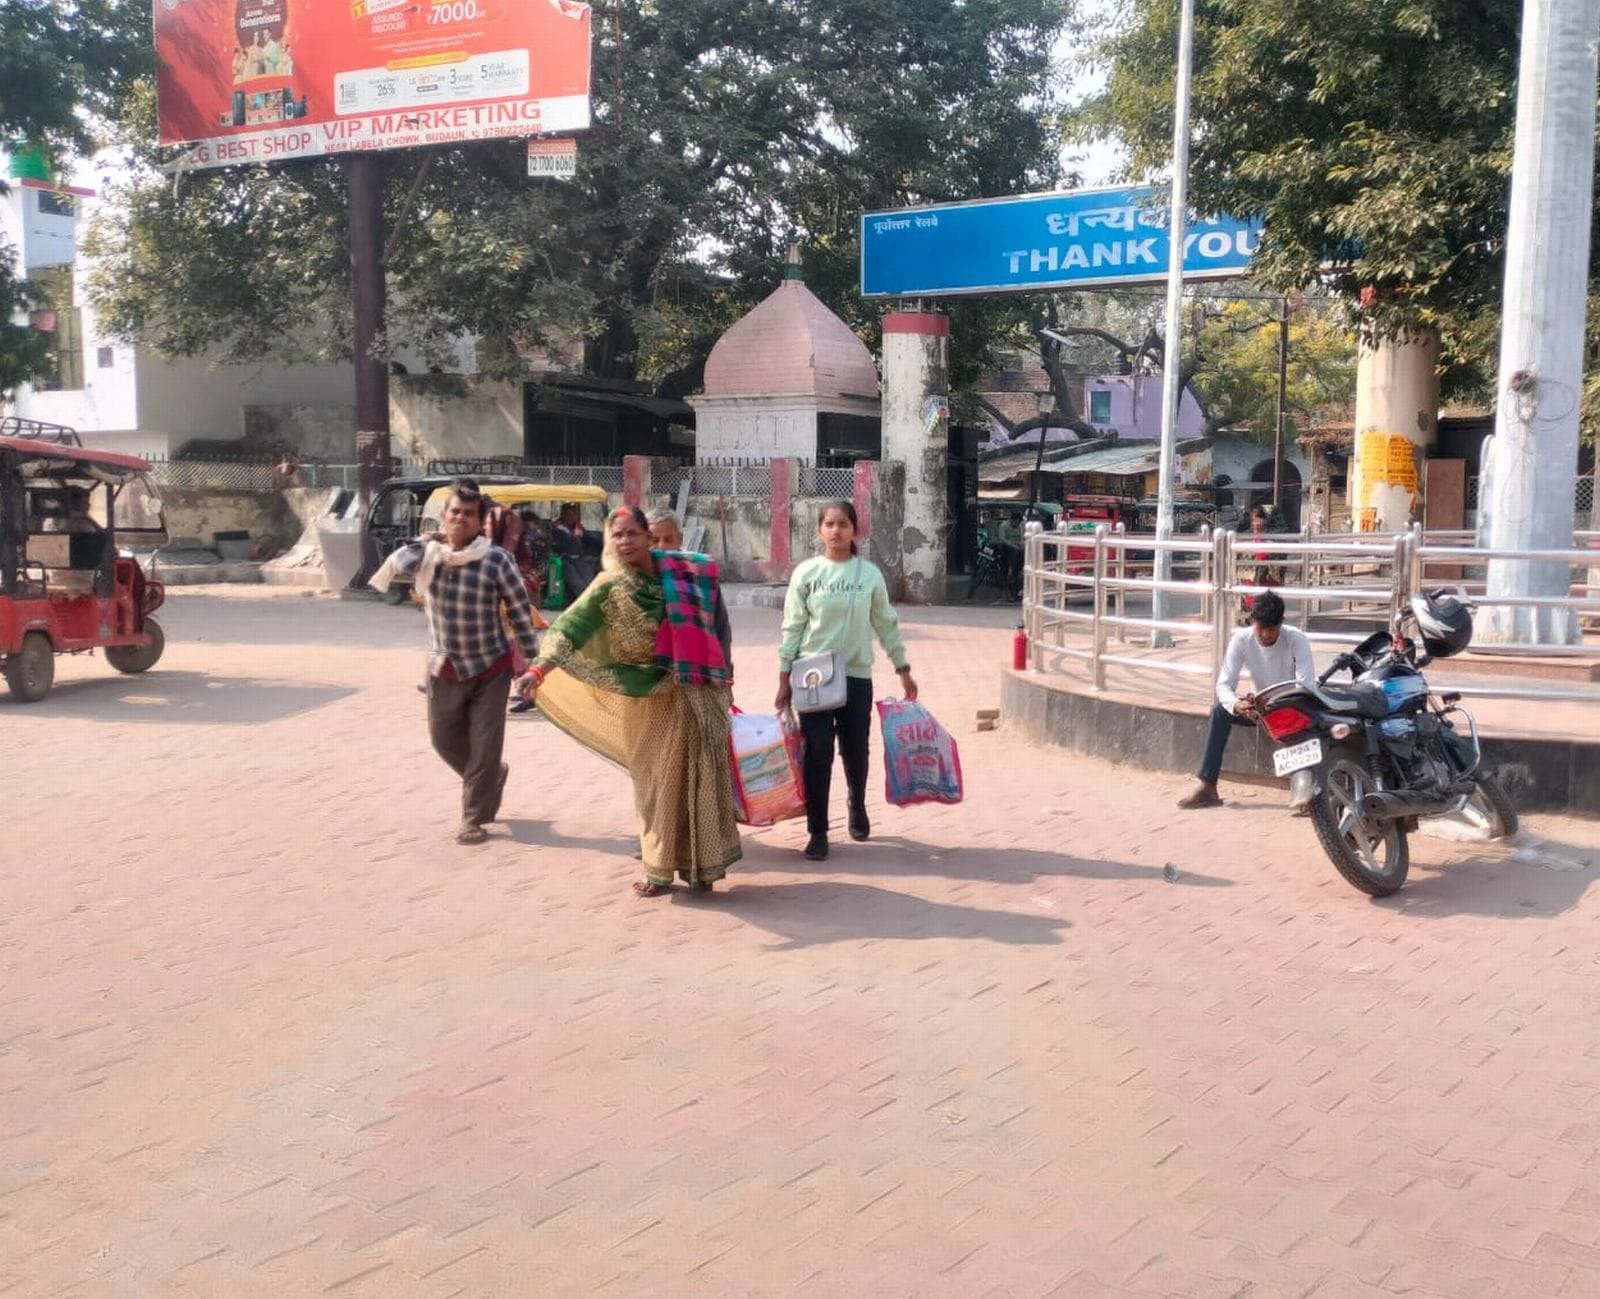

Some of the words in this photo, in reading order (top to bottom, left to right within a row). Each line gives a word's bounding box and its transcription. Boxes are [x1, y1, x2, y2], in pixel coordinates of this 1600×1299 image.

[322, 120, 363, 140] VIP
[371, 101, 541, 135] MARKETING
[216, 139, 258, 160] BEST
[263, 132, 312, 154] SHOP
[324, 142, 348, 151] NEAR
[914, 213, 939, 229] रेलवे
[1003, 238, 1158, 274] THANK
